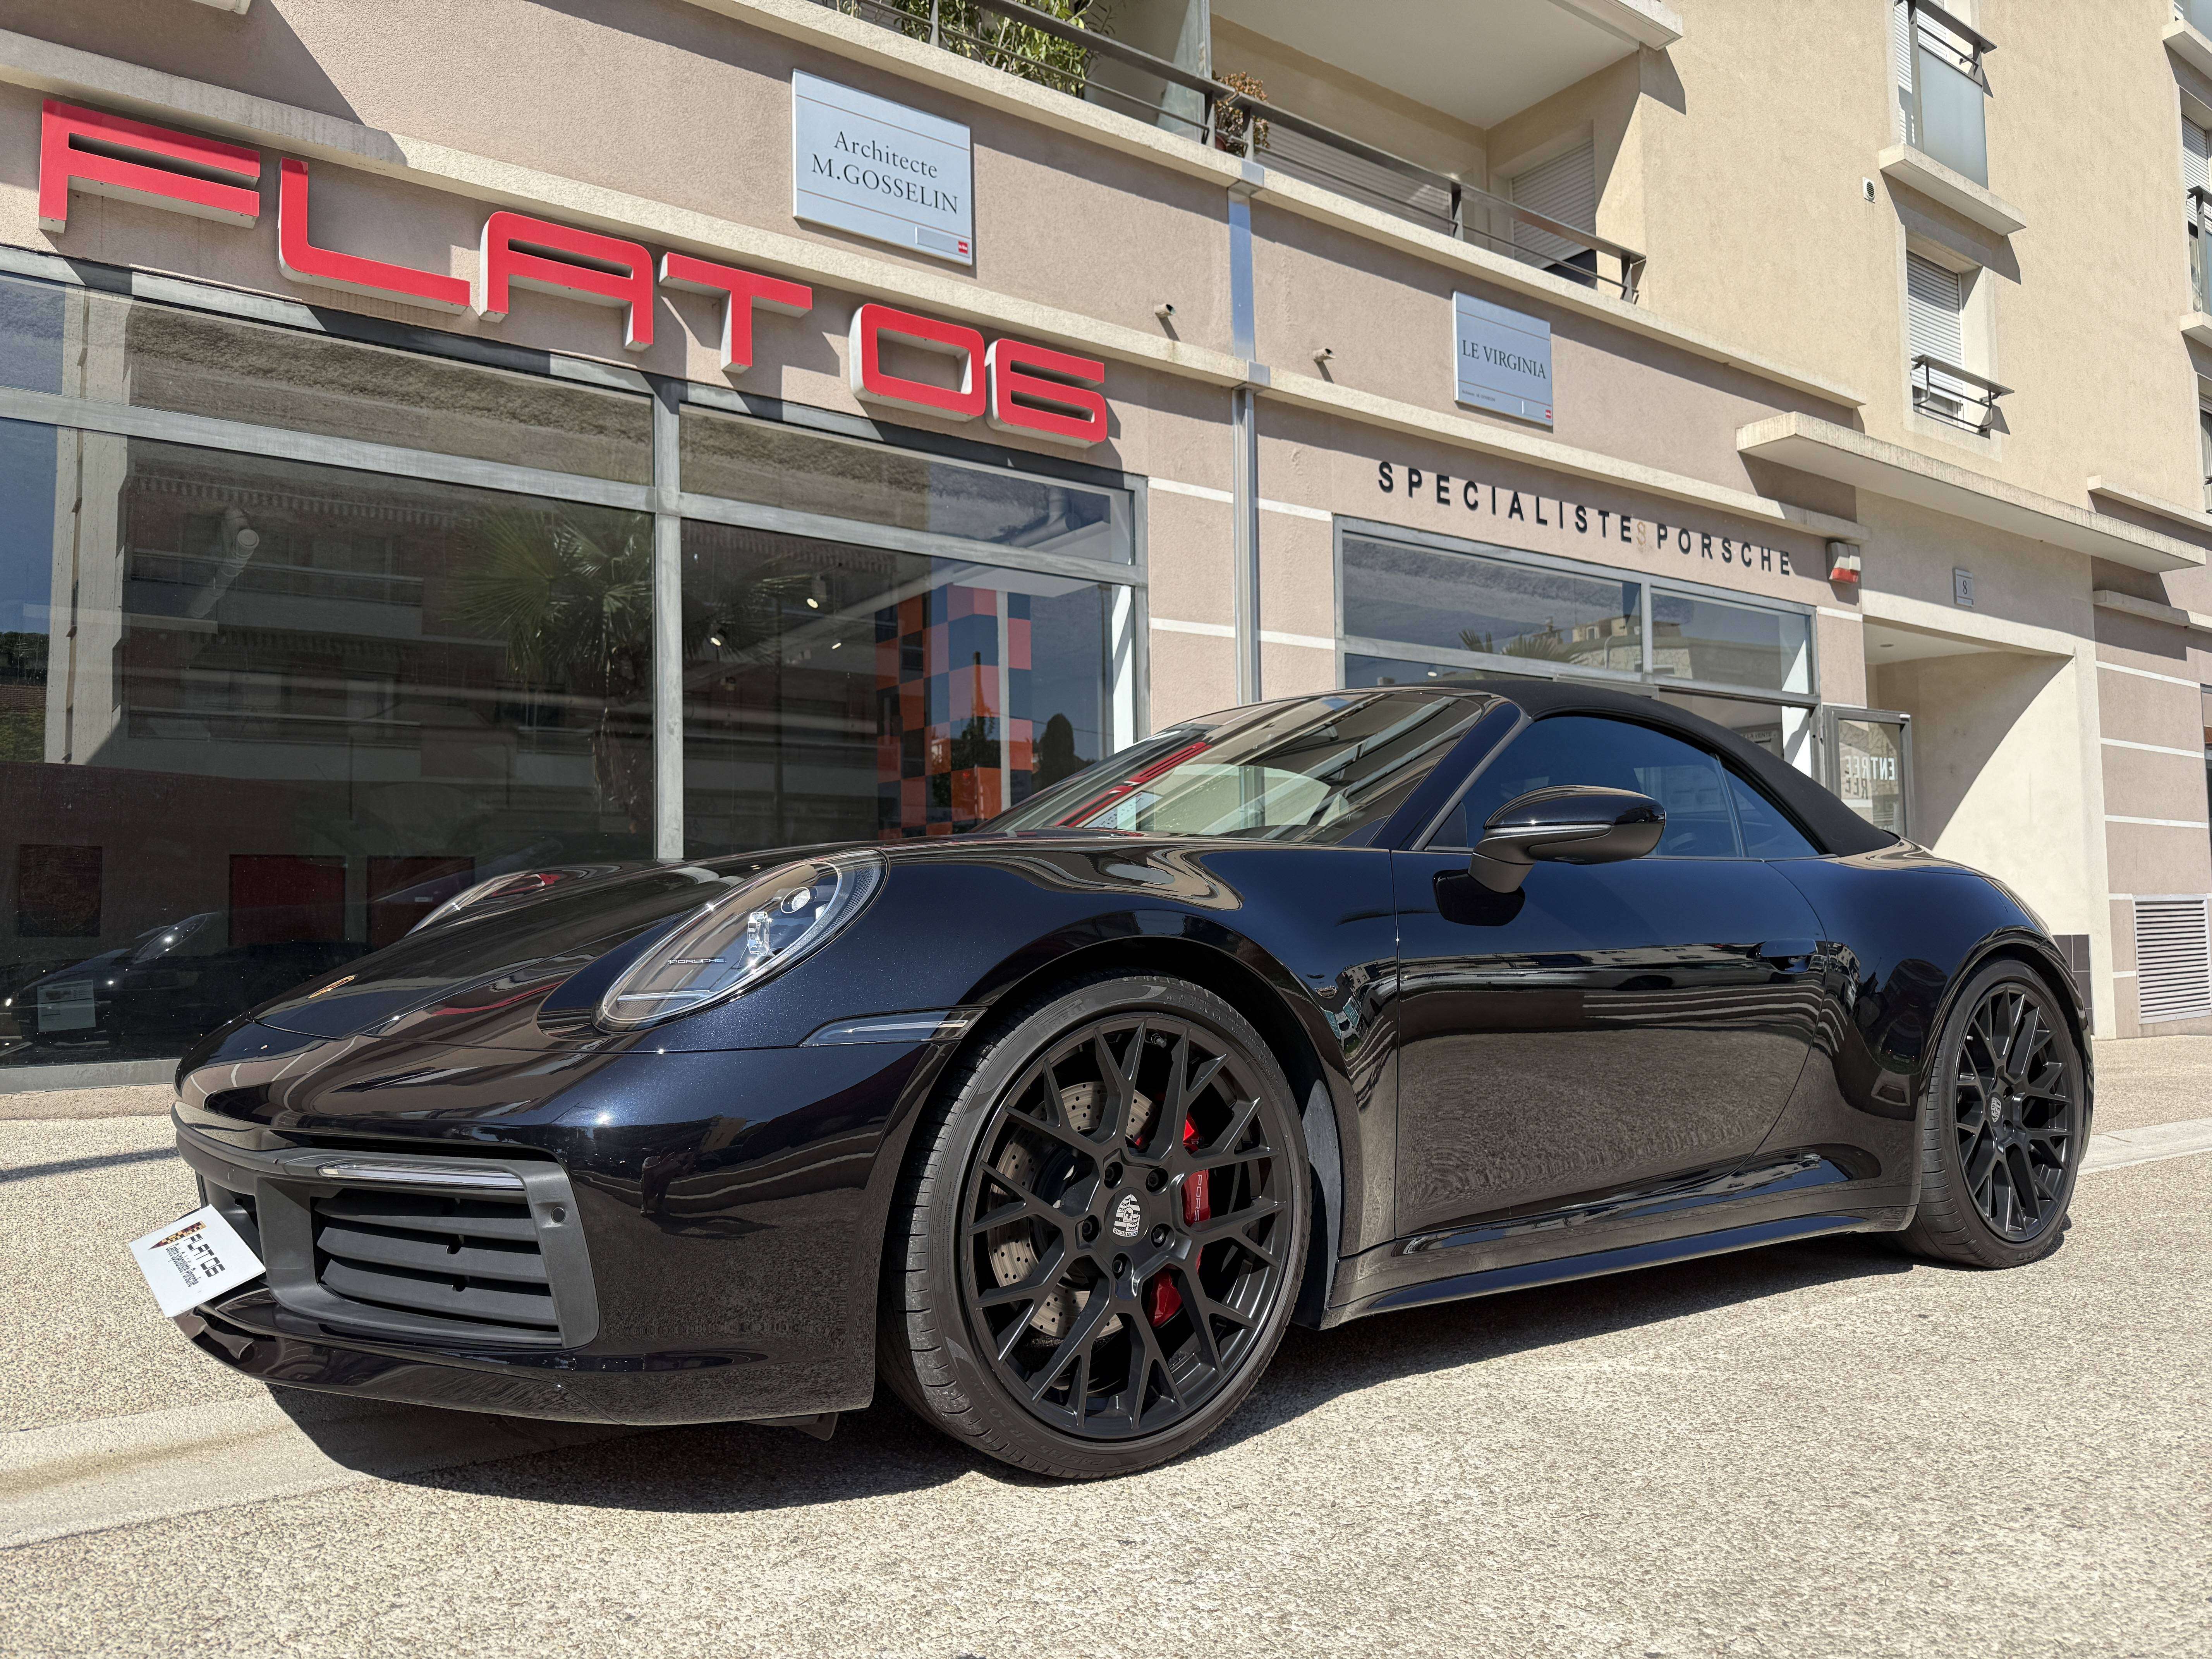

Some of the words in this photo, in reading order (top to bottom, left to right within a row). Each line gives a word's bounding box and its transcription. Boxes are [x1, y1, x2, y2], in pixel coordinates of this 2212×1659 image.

[834, 131, 938, 179] Architecte
[39, 99, 812, 373] FLAT
[849, 303, 1107, 448] 06
[1462, 340, 1479, 360] LE
[1482, 346, 1546, 379] VIRGINIA
[1377, 461, 1632, 543] SPECIALISTE
[1656, 523, 1791, 576] PORSCHE
[1963, 580, 1968, 595] 8
[1194, 1175, 1202, 1221] PORS
[1113, 1228, 1137, 1237] PORSCHE
[165, 1243, 180, 1258] Centre
[181, 1267, 201, 1288] Porsche
[183, 1233, 215, 1260] FLAT
[200, 1257, 225, 1278] 06
